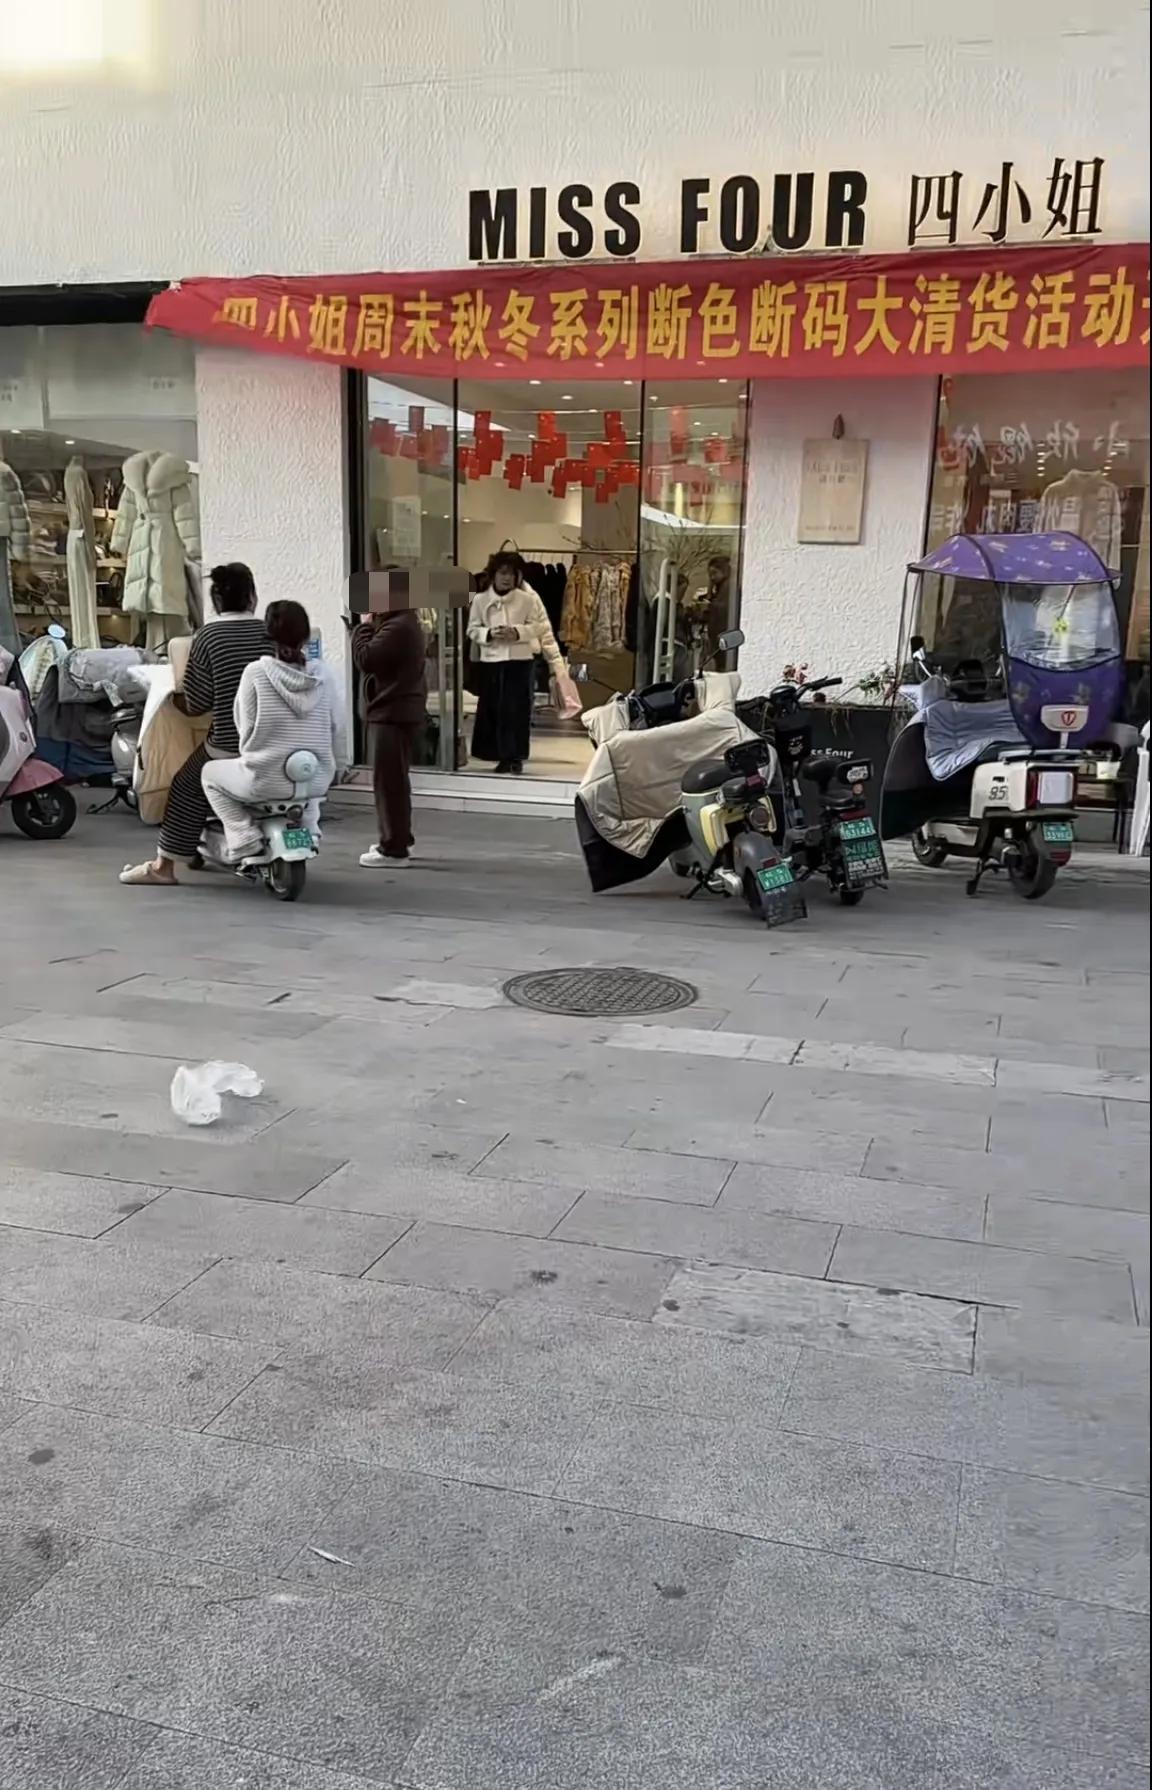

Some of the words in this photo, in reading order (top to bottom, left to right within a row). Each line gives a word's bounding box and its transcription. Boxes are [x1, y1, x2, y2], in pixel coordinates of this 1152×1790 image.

[469, 182, 641, 260] MISS
[680, 171, 867, 255] FOUR
[907, 157, 1105, 246] 四小姐
